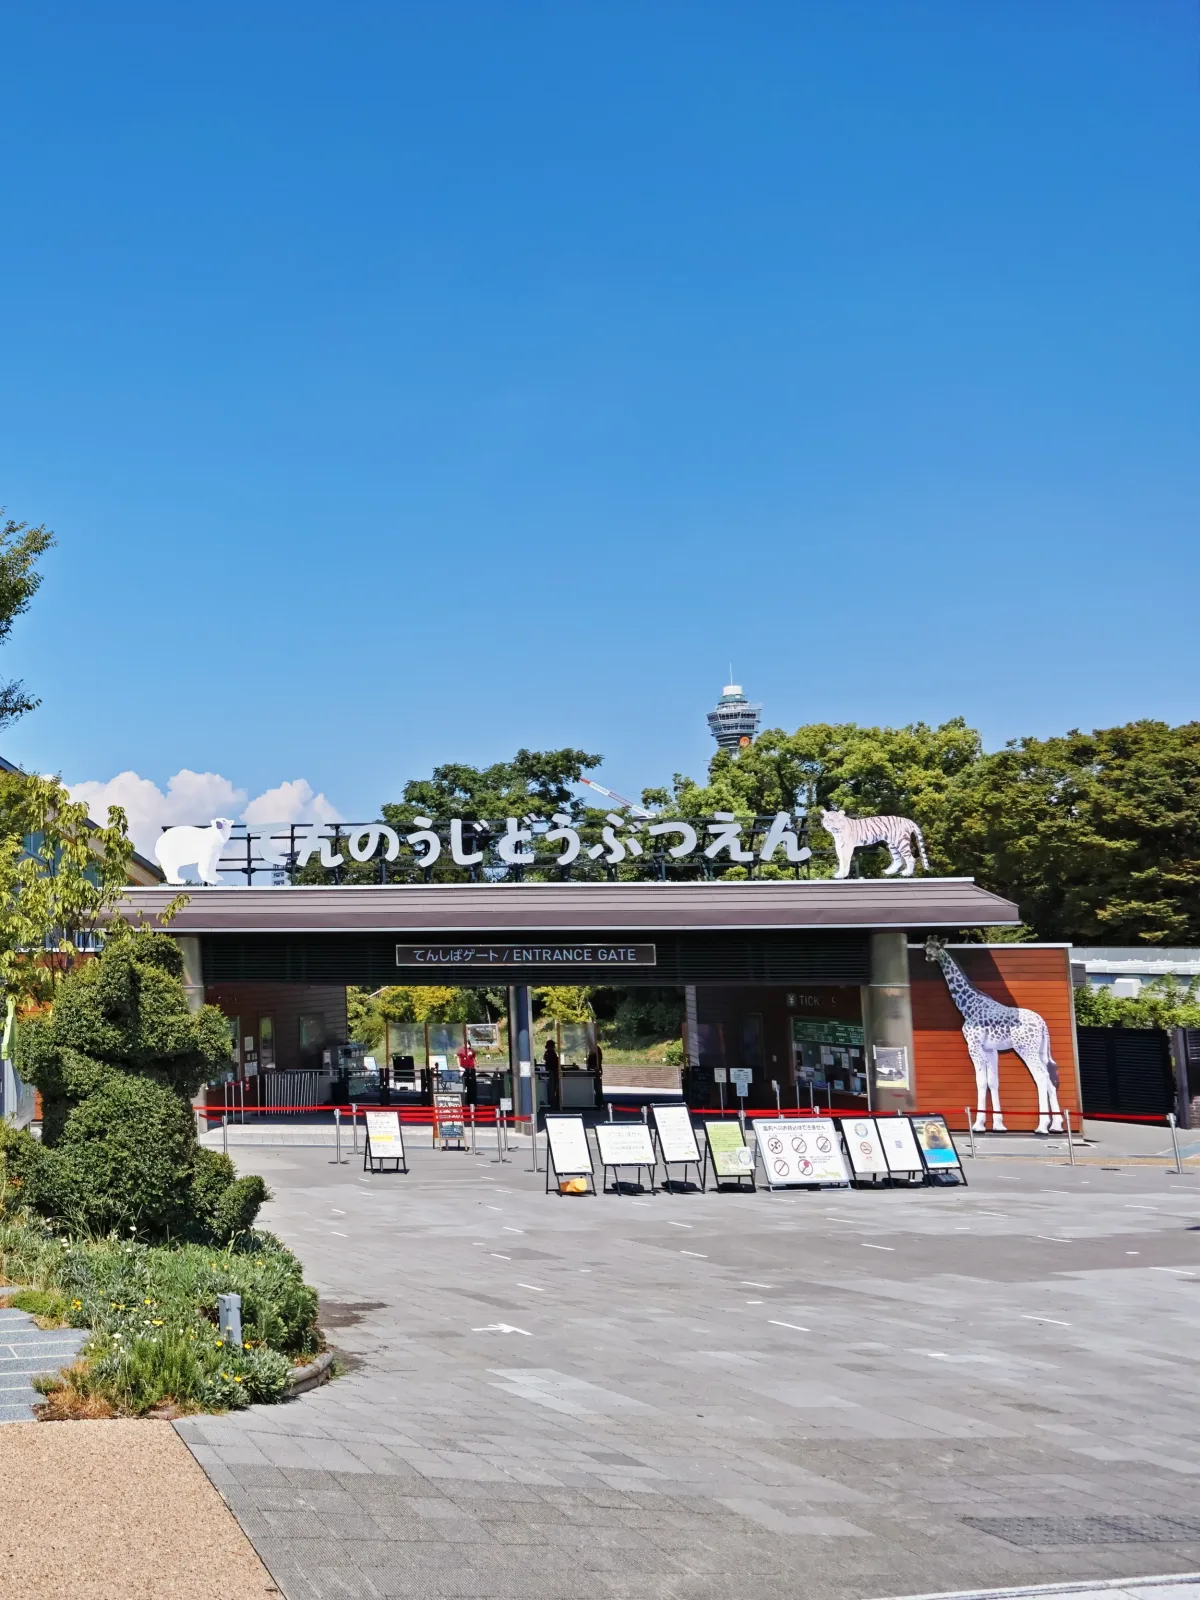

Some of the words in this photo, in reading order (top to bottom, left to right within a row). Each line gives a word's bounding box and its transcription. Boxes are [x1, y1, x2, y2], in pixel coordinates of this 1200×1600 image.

[248, 810, 812, 867] てんのうじどうぶつえん
[413, 948, 499, 962] てんしばゲート
[513, 949, 593, 961] ENTRANCE
[597, 949, 637, 961] GATE
